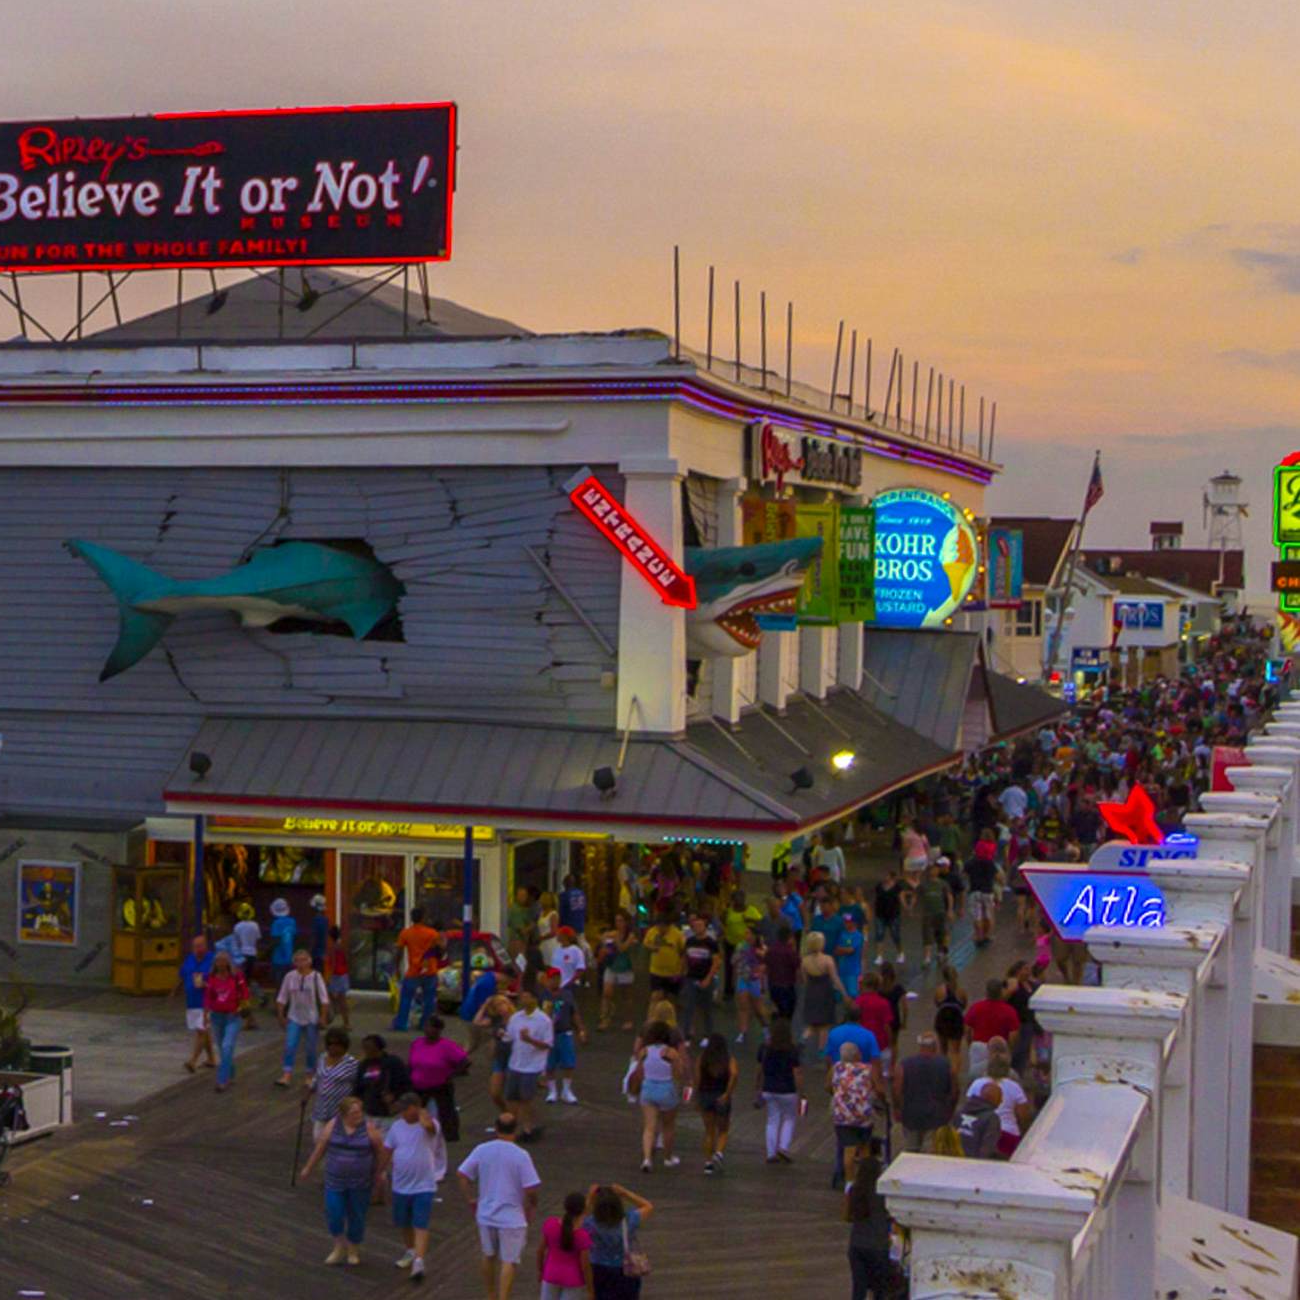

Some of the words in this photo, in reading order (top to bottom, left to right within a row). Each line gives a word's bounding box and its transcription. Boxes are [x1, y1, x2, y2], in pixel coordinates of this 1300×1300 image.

[174, 166, 222, 215] It
[239, 177, 299, 214] or
[240, 213, 403, 230] MUSEUM
[35, 243, 78, 260] FOR
[83, 242, 128, 258] THE
[133, 240, 209, 257] WHOLE
[583, 488, 676, 587] ENTRANCE
[875, 533, 936, 556] KOHR
[875, 558, 933, 581] BROS
